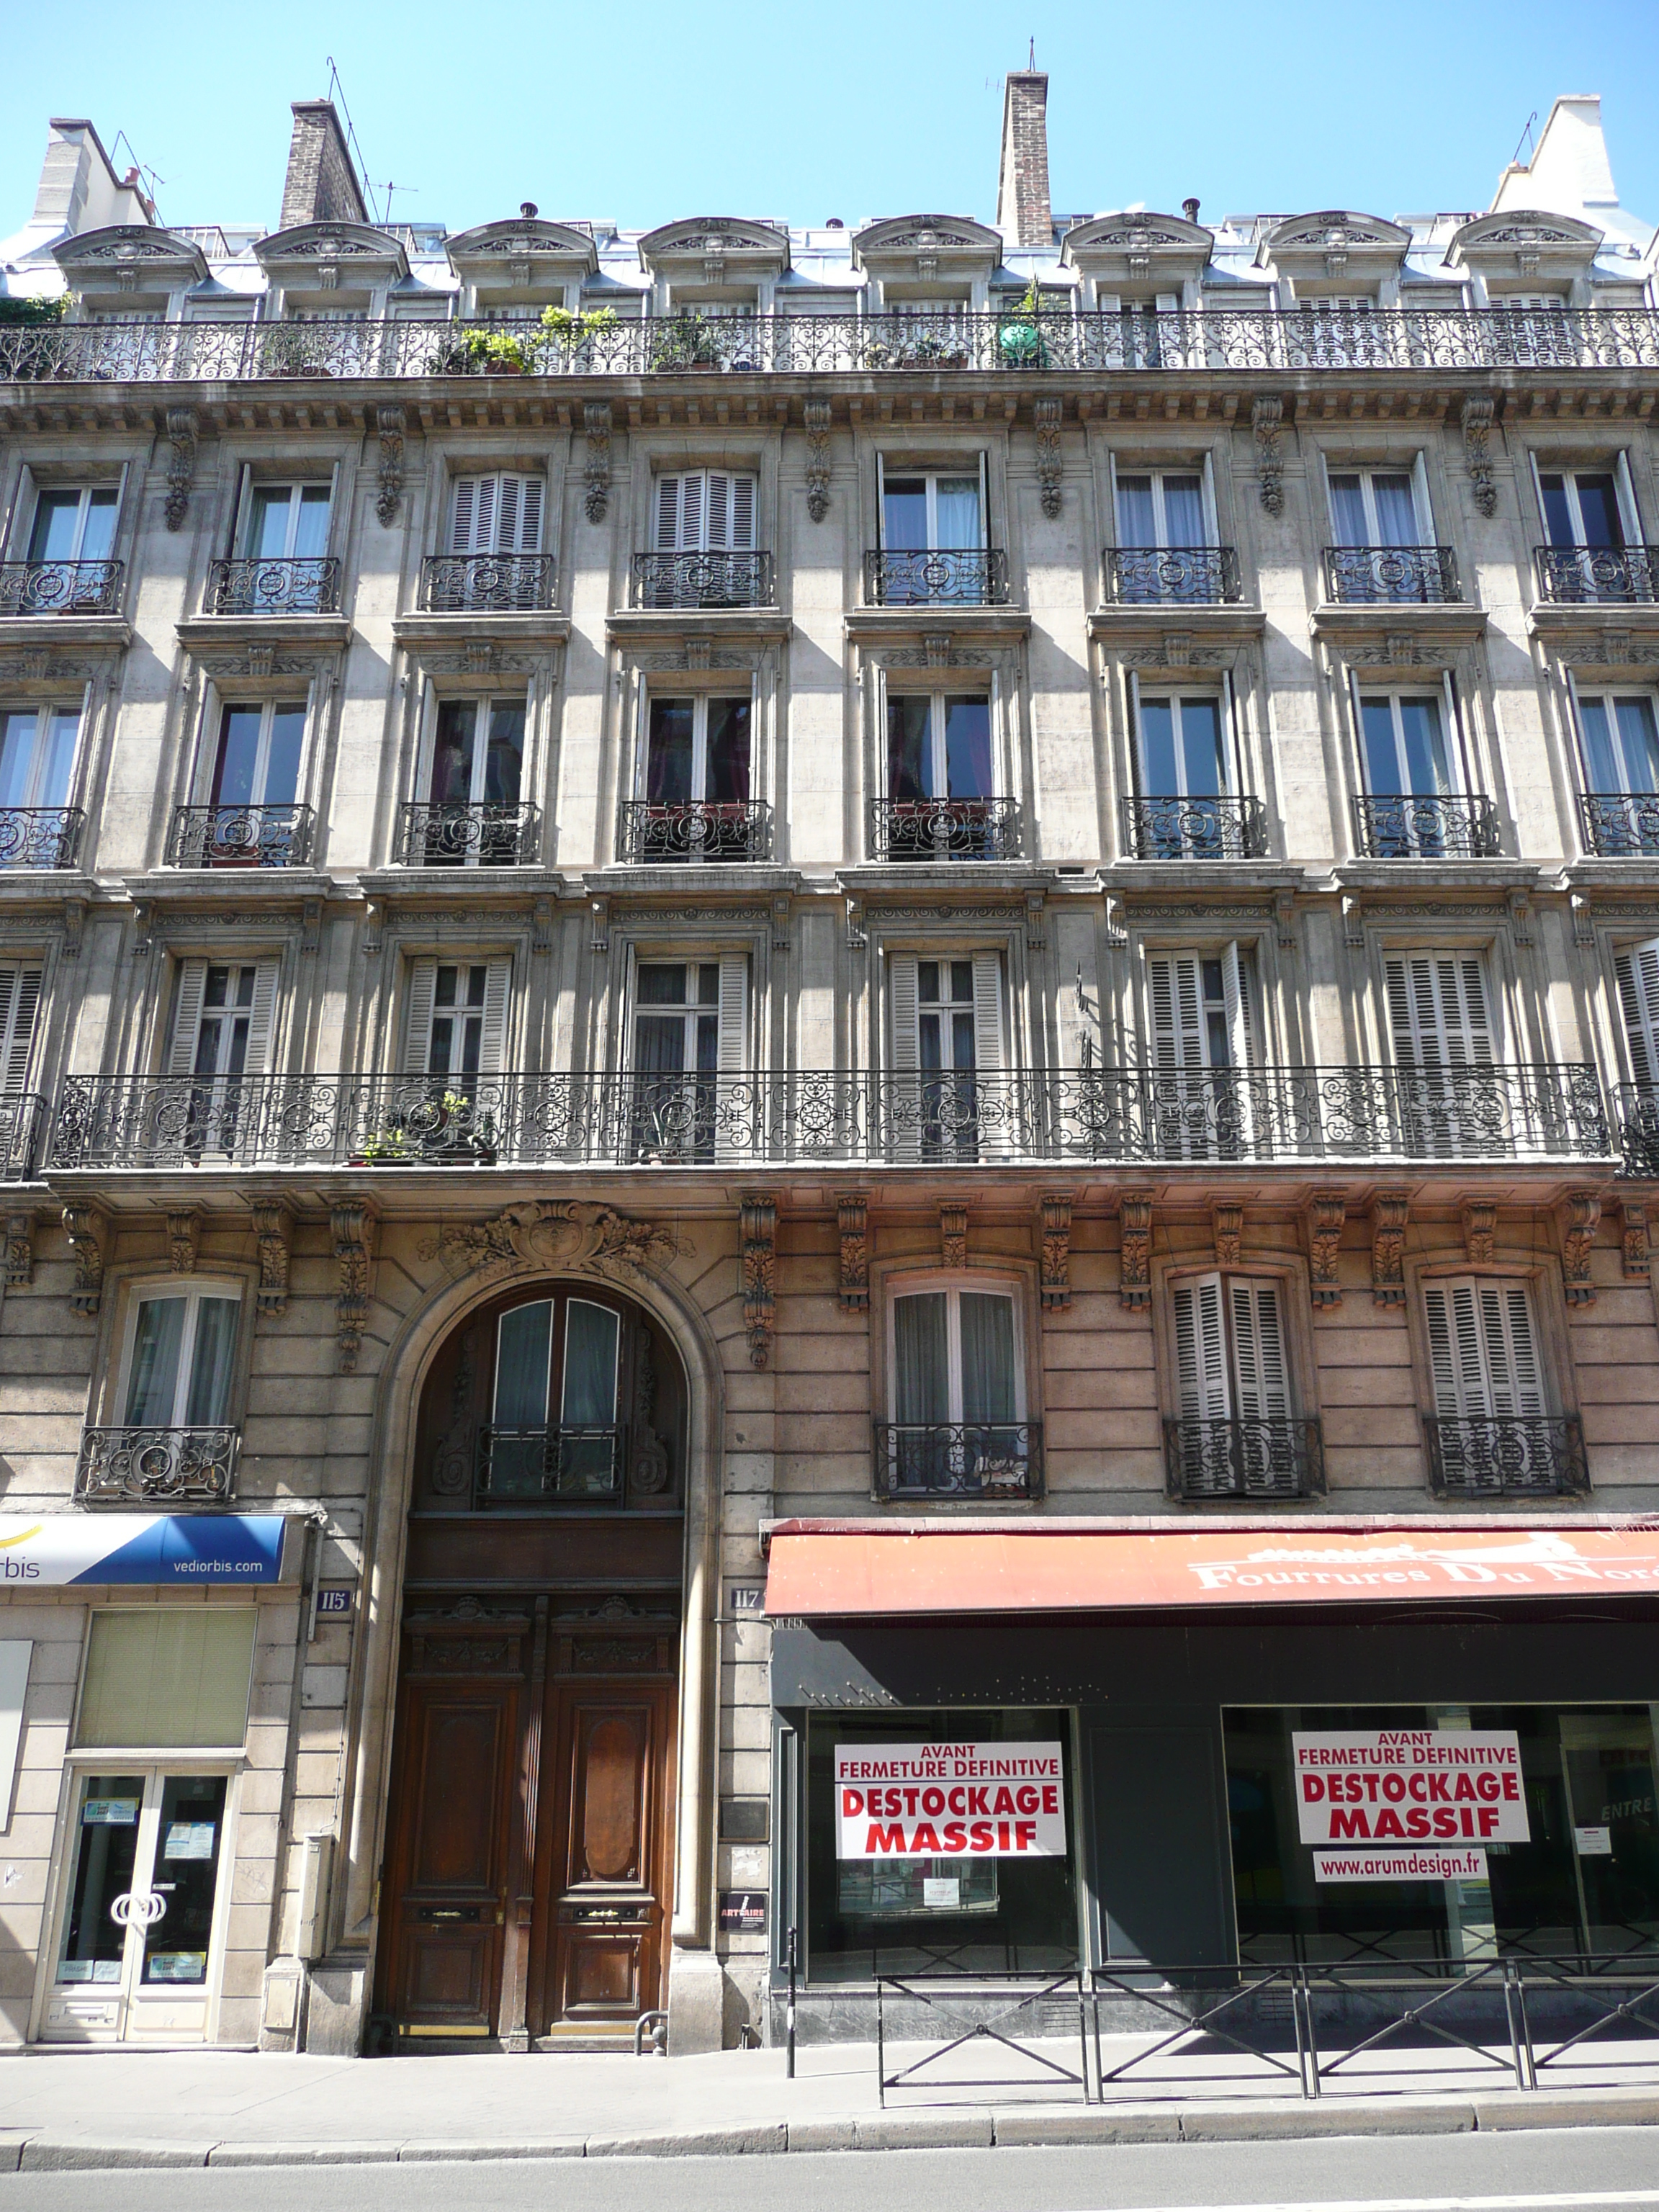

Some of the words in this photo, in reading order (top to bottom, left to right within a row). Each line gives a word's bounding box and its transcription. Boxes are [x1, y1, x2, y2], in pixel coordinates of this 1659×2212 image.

[174, 1560, 263, 1573] vediorbis.com
[1189, 1565, 1431, 1589] Fourrures
[1432, 1562, 1534, 1583] Du
[1533, 1561, 1659, 1581] Nor
[322, 1592, 345, 1610] 115
[735, 1590, 759, 1608] 117
[1378, 1732, 1432, 1745] AVANT
[920, 1745, 976, 1758] AVANT
[1298, 1748, 1406, 1765] FERMETURE
[1412, 1747, 1516, 1764] DEFINITIVE
[840, 1761, 947, 1778] FERMETURE
[954, 1759, 1058, 1776] DEFINITIVE
[1302, 1771, 1520, 1803] DESTOCKAGE
[842, 1785, 1058, 1817] DESTOCKAGE
[1329, 1807, 1500, 1839] MASSIF
[865, 1820, 1036, 1853] MASSIF
[1321, 1852, 1480, 1878] www.arumdesign.fr
